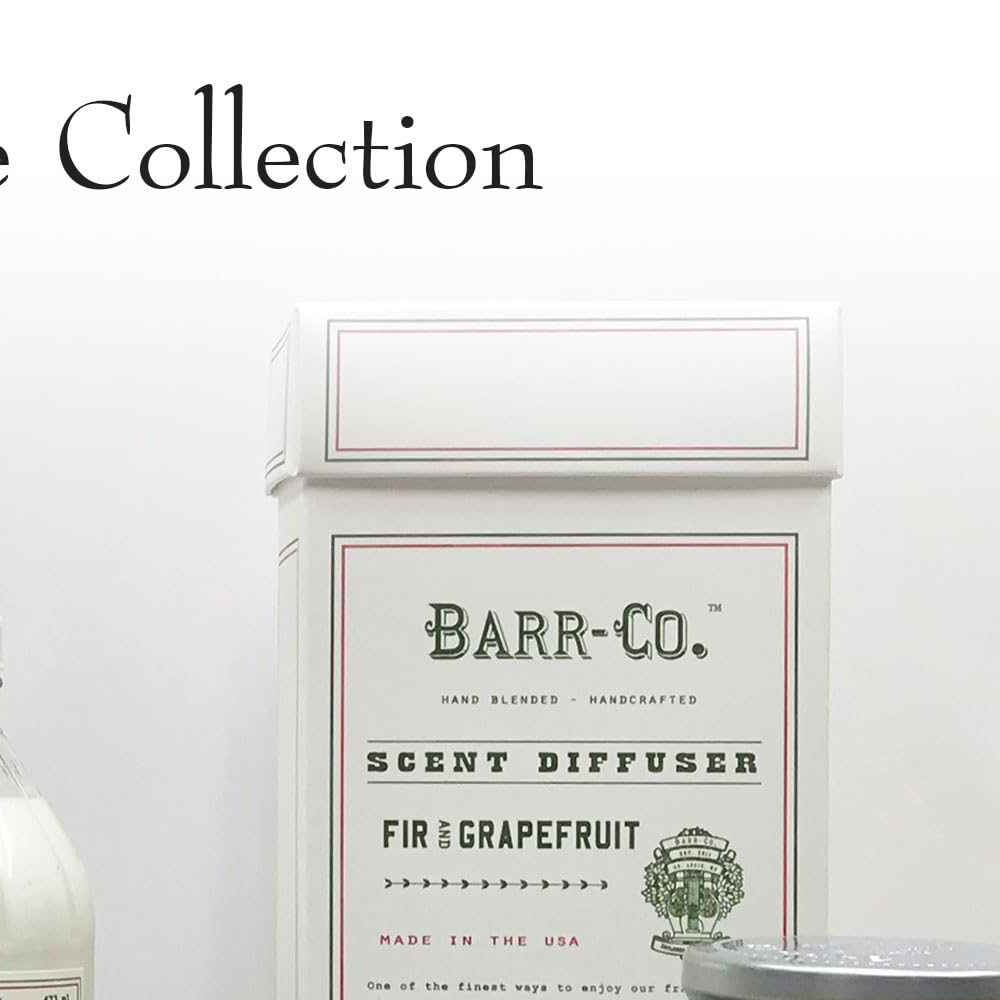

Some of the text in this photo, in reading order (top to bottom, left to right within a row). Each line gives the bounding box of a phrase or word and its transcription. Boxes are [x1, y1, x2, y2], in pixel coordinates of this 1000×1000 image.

[441, 695, 697, 705] HAND BLENDED HANDCRAFTED
[367, 752, 757, 773] SCENT DIFFUSER
[383, 819, 428, 849] FIR
[438, 819, 450, 849] AND
[459, 820, 640, 849] GRAPEFRUIT
[380, 935, 579, 947] MADE IN THE USA
[368, 982, 654, 994] One of the finest ways to enjoy our
